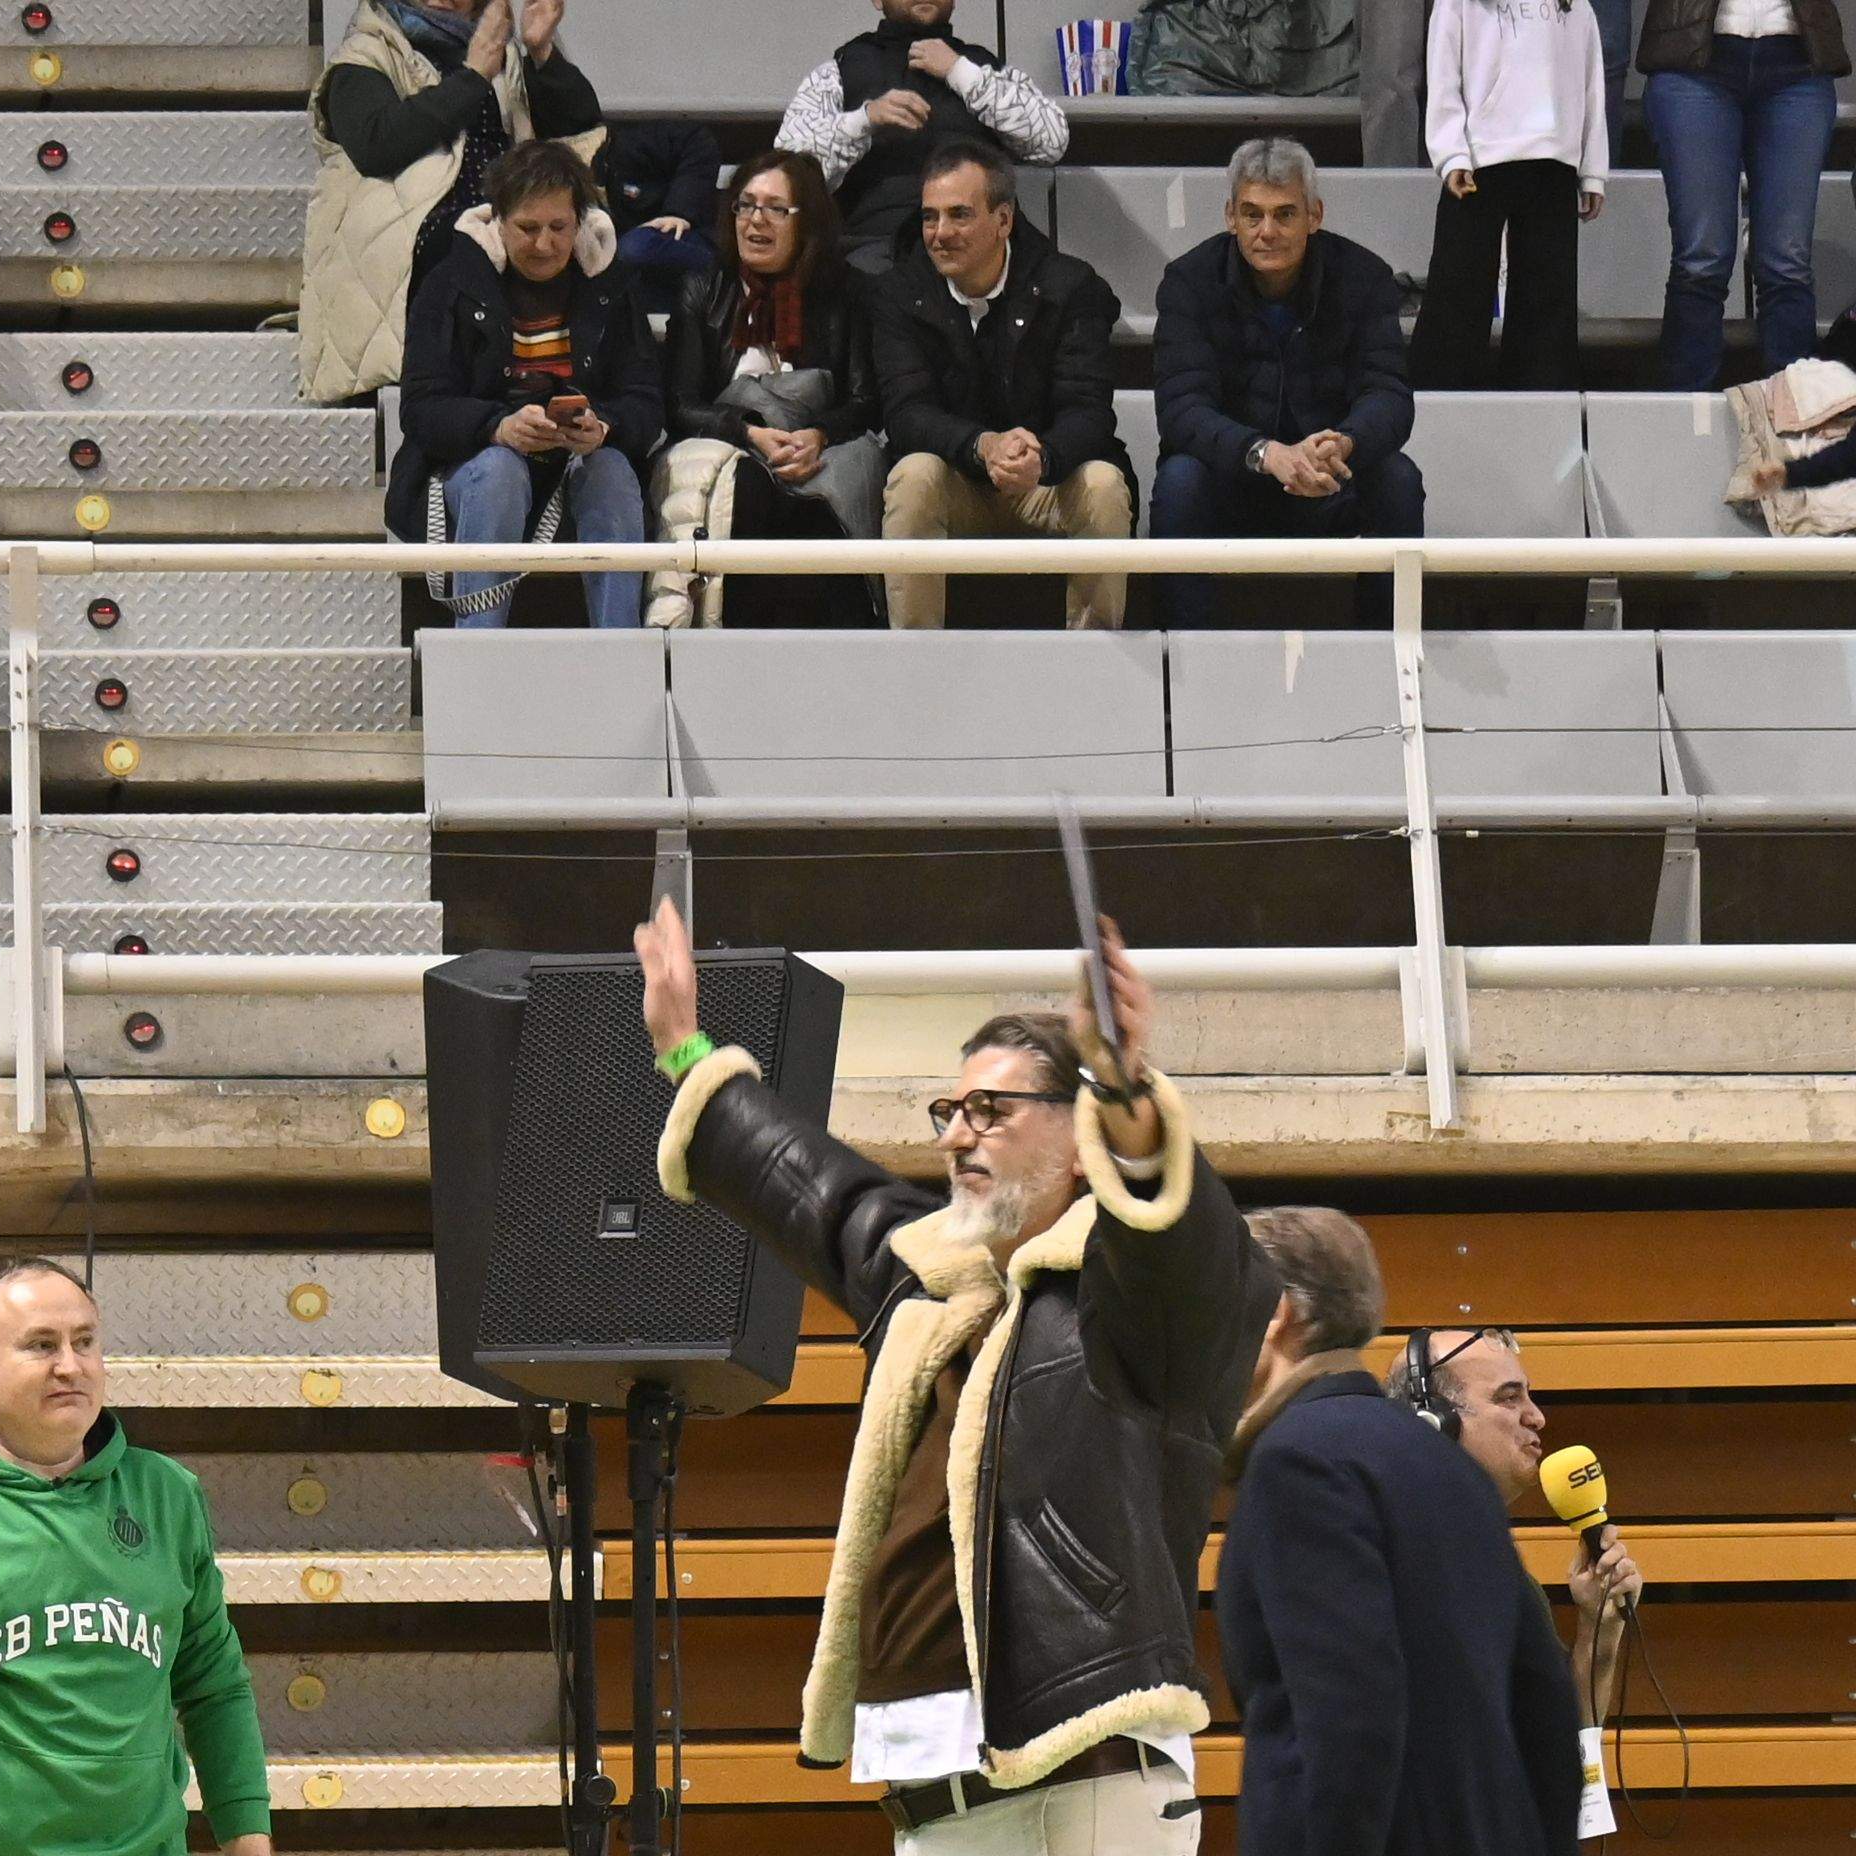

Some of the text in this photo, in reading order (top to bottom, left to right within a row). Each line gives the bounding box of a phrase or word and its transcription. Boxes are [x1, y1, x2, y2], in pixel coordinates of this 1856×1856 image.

[612, 1211, 630, 1224] JBL
[1568, 1461, 1603, 1490] SE
[44, 1597, 162, 1669] PEÑAS
